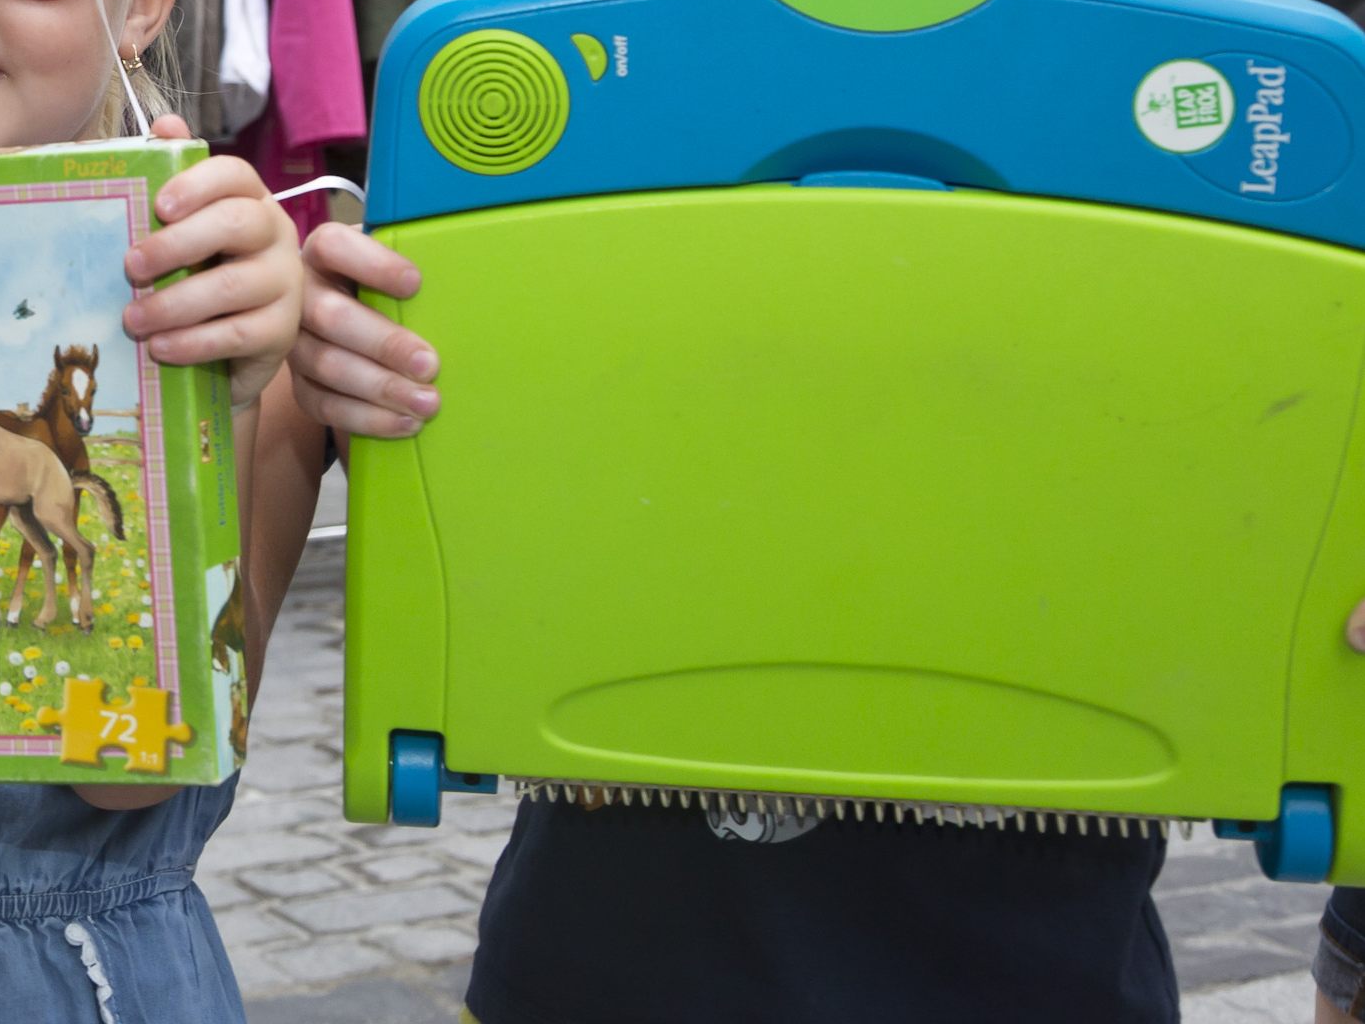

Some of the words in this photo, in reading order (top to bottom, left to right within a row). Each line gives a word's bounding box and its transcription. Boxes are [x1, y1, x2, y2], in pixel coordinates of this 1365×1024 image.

[613, 35, 628, 77] on/off
[1176, 88, 1196, 125] LEAP
[1195, 85, 1218, 124] FROG
[1240, 63, 1291, 195] LeapPad
[63, 153, 127, 177] Puzzle
[99, 710, 138, 744] 72
